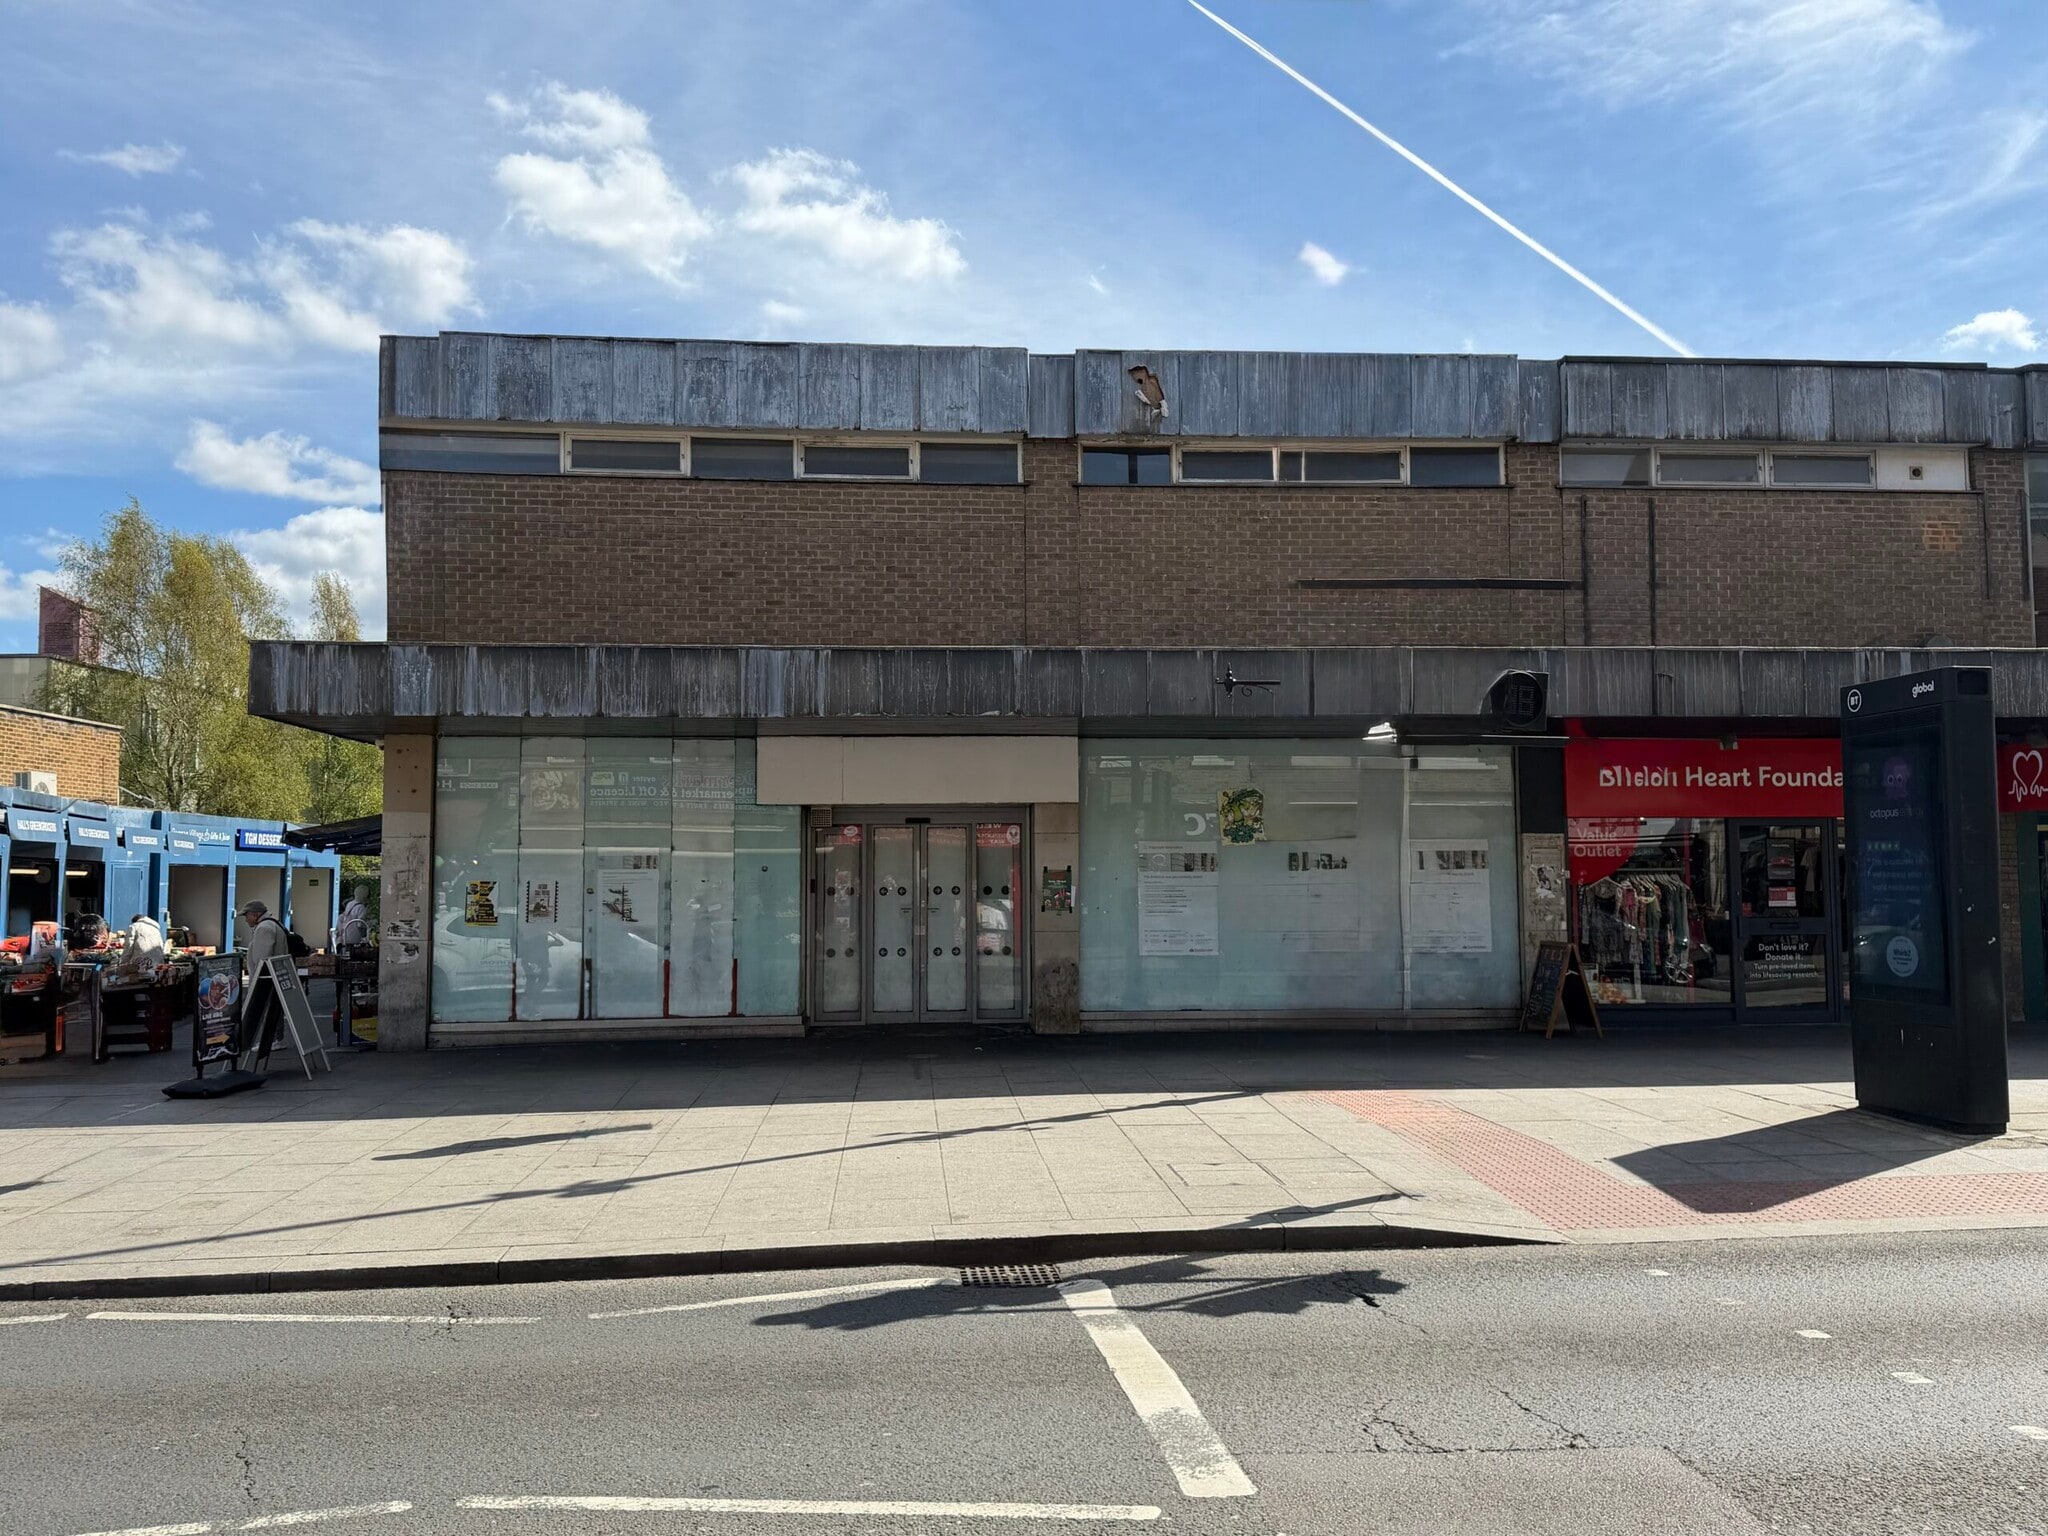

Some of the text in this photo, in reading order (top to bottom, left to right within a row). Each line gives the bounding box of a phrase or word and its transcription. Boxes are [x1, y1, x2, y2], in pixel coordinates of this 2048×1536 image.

[1911, 680, 1935, 698] global
[1850, 696, 1859, 706] BT
[1685, 766, 1751, 787] Heart
[1759, 765, 1844, 787] Founda
[1869, 808, 1900, 820] octopus
[245, 832, 258, 845] TGH
[1576, 827, 1617, 840] Value
[1574, 844, 1622, 858] Outlet
[1758, 943, 1810, 952] Don't love it?
[1765, 953, 1794, 962] Donate
[1753, 963, 1768, 971] Turn
